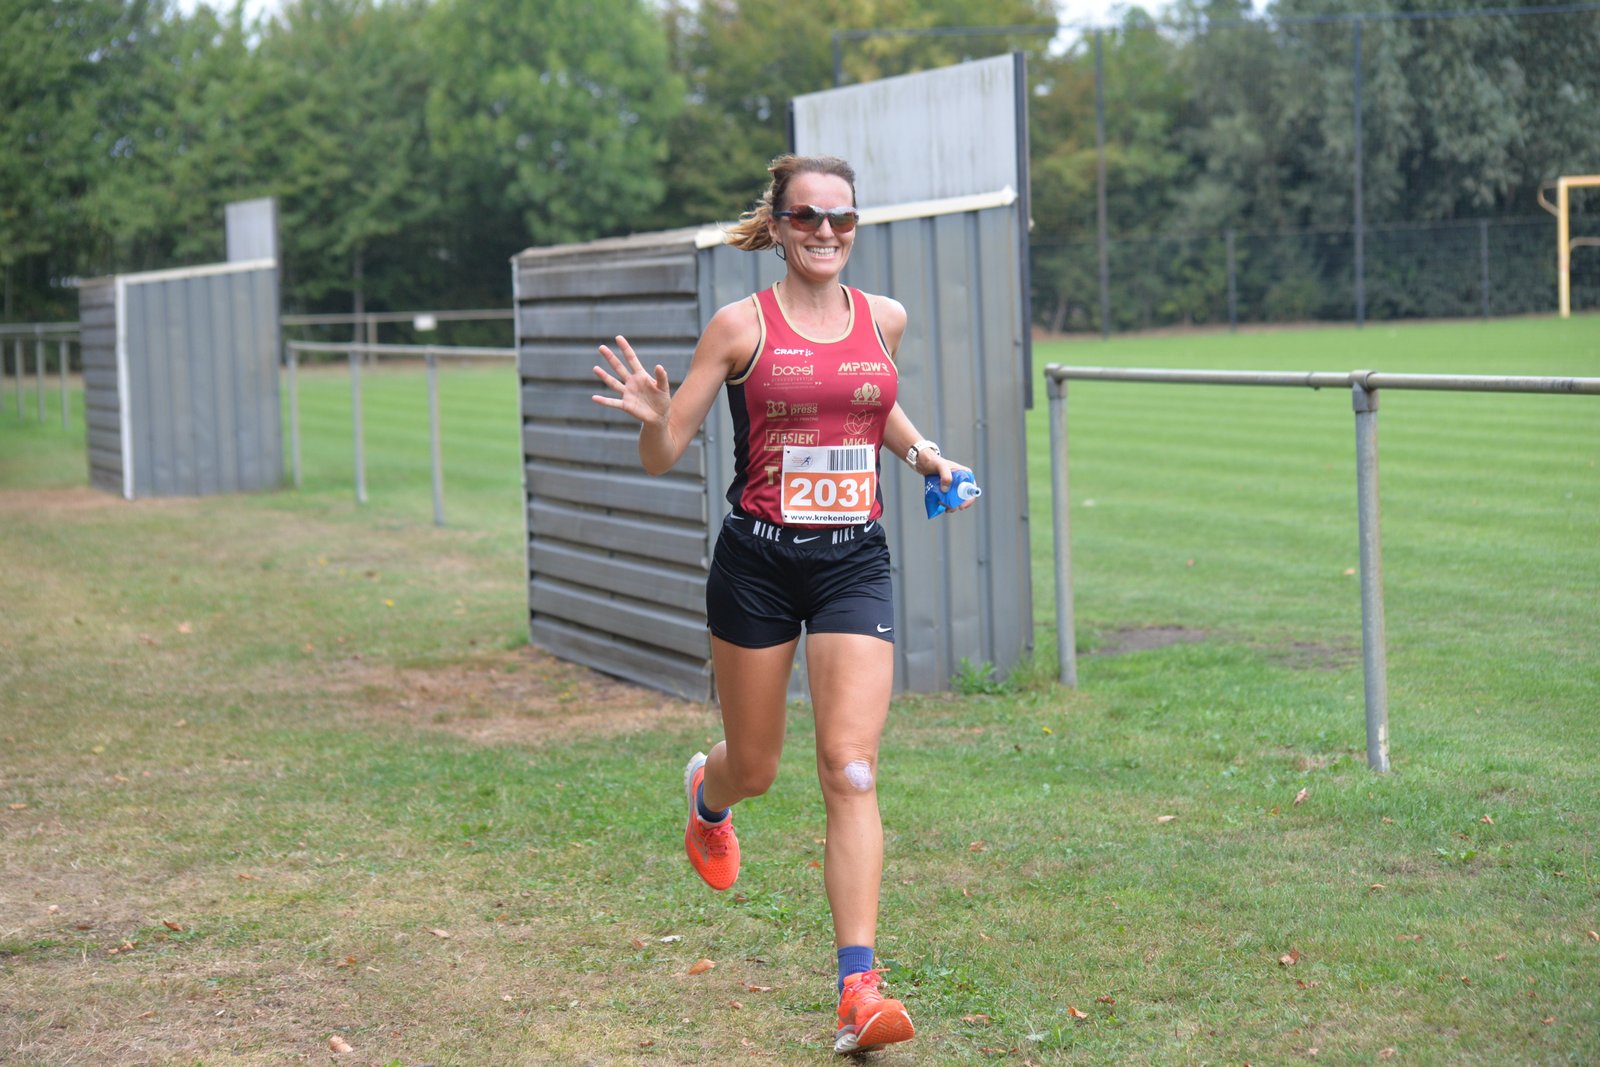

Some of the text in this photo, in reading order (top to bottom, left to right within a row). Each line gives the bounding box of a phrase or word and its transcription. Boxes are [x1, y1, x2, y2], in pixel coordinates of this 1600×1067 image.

[790, 406, 818, 415] press
[769, 433, 814, 445] FIESIEK
[790, 477, 870, 507] 2031
[791, 514, 868, 522] www.krekenlopers.
[753, 520, 781, 542] NIKE
[832, 526, 855, 545] NIKE
